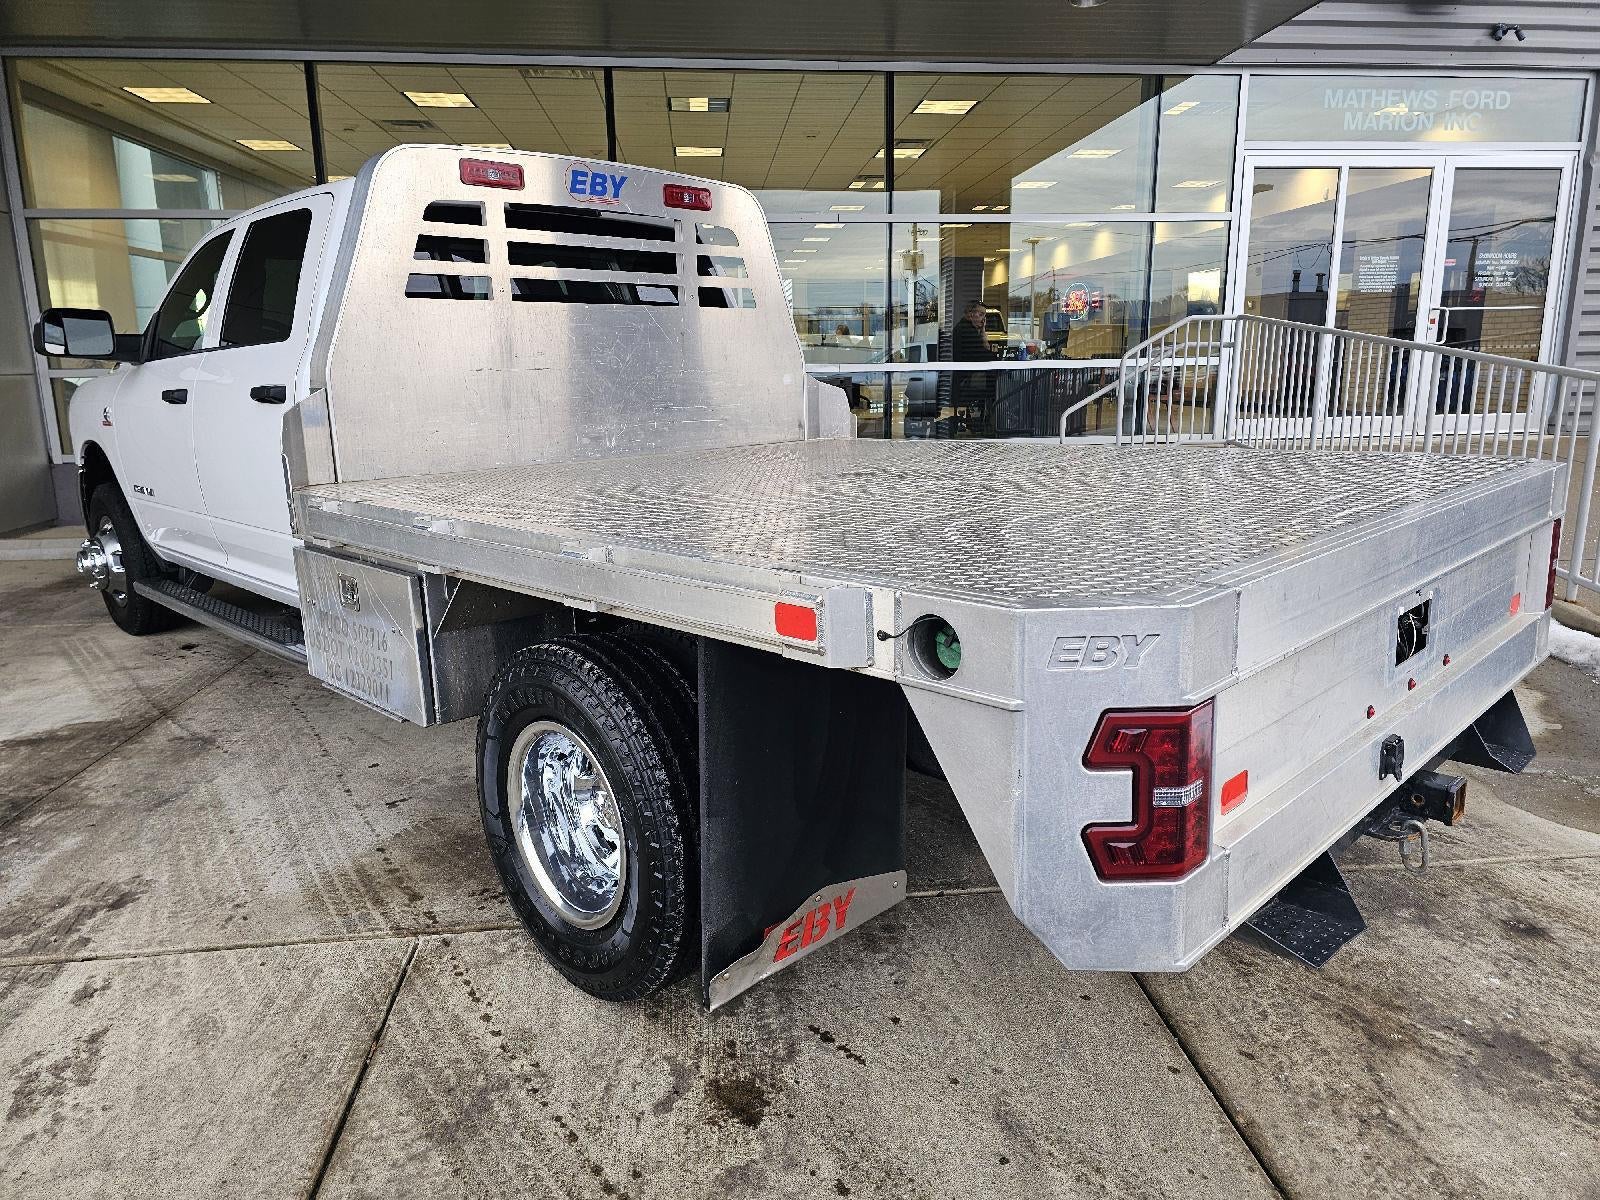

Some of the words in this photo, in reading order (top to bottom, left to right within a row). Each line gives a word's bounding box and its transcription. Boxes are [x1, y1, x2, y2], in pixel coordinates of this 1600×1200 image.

[1324, 88, 1438, 110] MATHEWS
[1449, 90, 1511, 110] FORD
[1343, 111, 1433, 132] MARION
[570, 170, 628, 199] EBY
[1046, 633, 1161, 671] EBY
[773, 886, 857, 963] EBY
